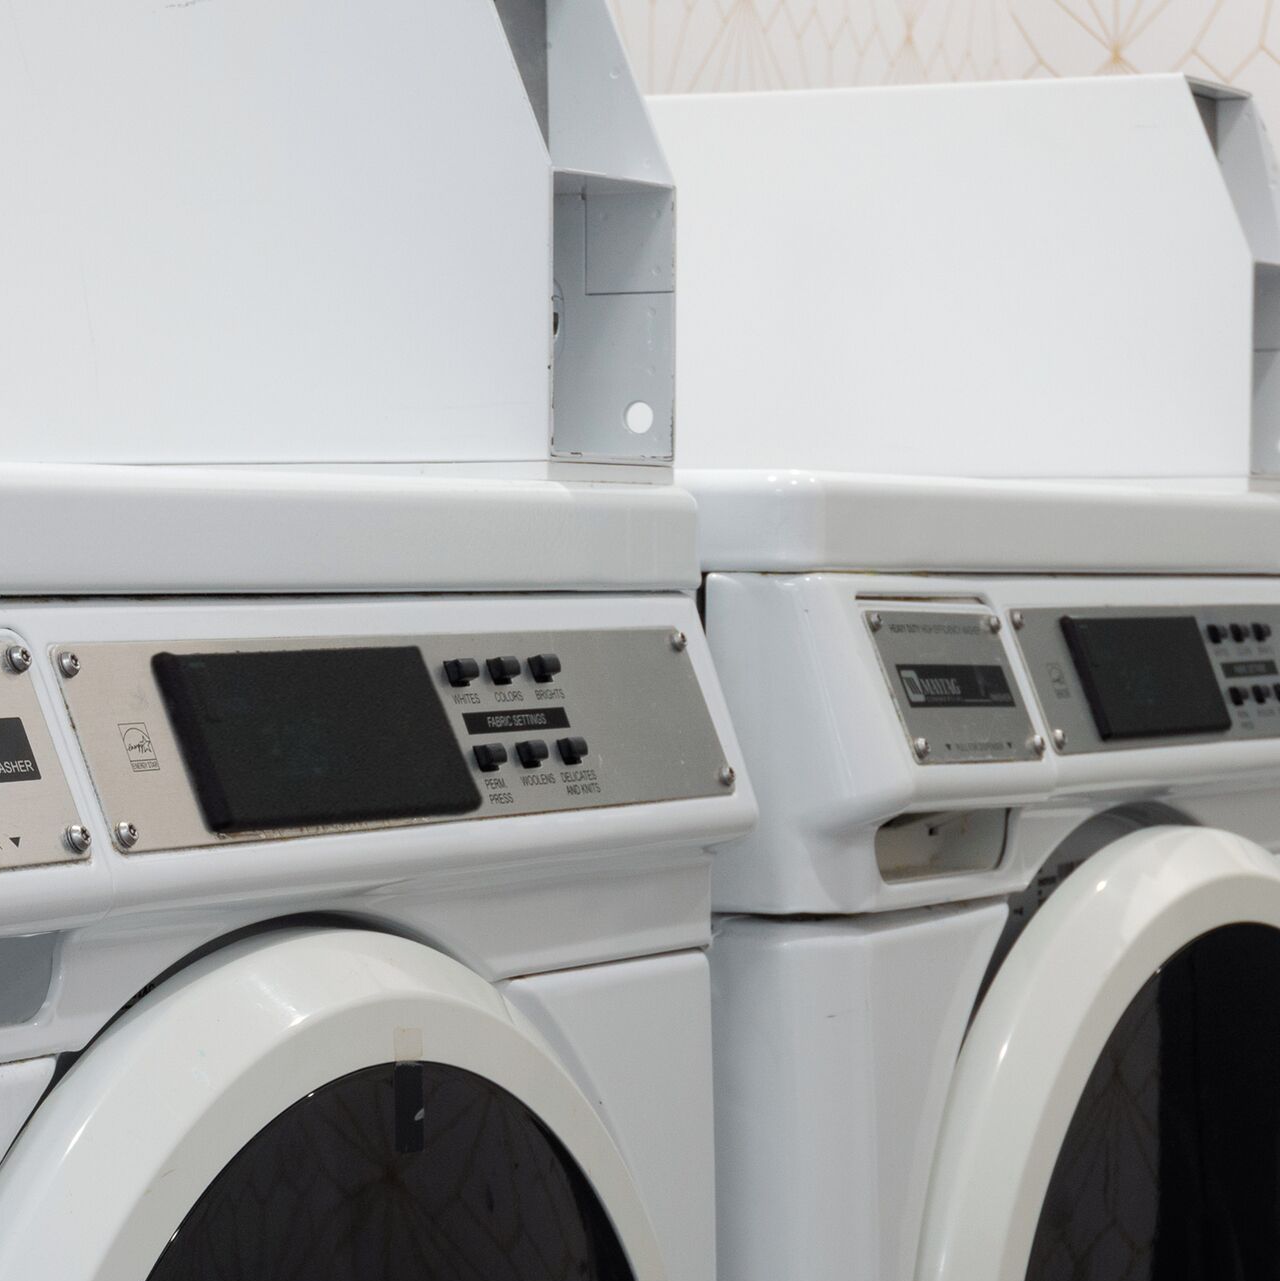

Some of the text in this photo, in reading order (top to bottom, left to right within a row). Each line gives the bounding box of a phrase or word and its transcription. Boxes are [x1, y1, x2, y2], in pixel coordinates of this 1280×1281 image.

[453, 693, 480, 704] WHITES
[494, 690, 524, 703] COLORS
[535, 688, 565, 700] BRIGHTS
[487, 713, 547, 728] FABRIC SETTINGS
[521, 773, 556, 786] WOOLENS
[560, 769, 598, 783] DELICATES
[566, 782, 601, 796] AND KNITS
[489, 792, 514, 805] PRESS
